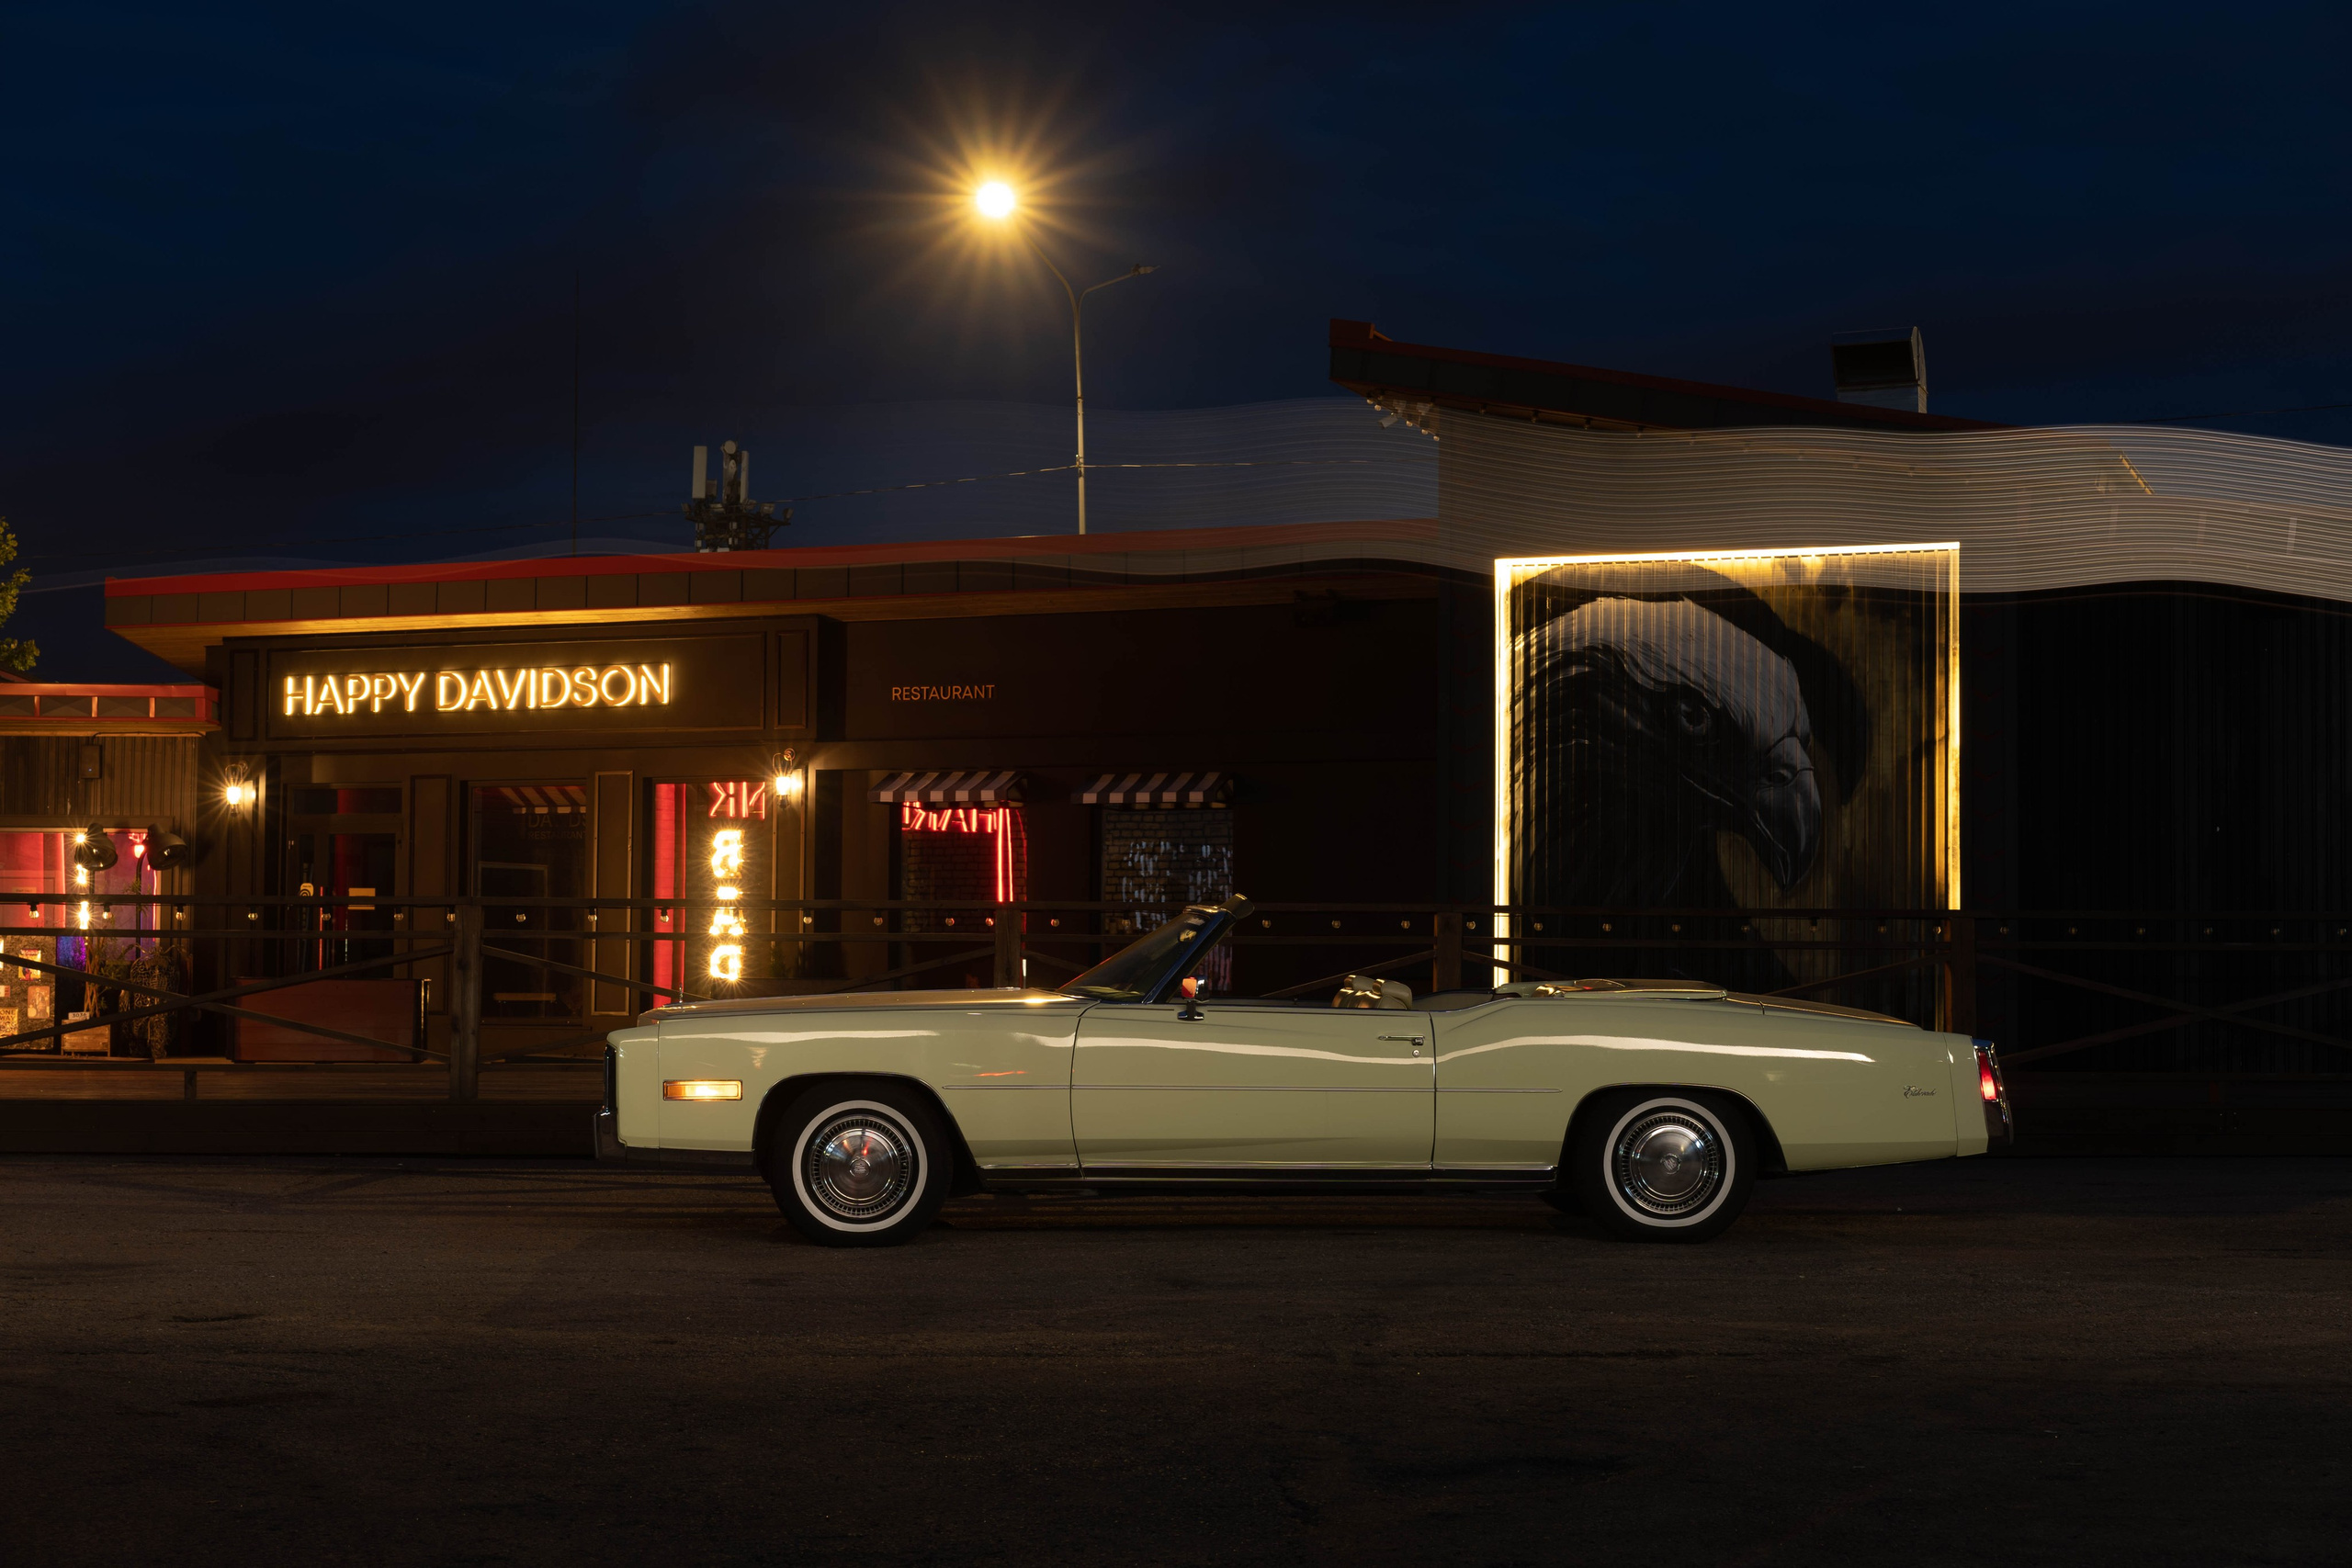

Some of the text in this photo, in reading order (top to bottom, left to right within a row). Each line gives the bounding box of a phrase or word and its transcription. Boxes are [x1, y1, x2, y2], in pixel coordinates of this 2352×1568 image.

[283, 662, 670, 716] HAPPY DAVIDSON
[891, 684, 995, 701] RESTAURANT
